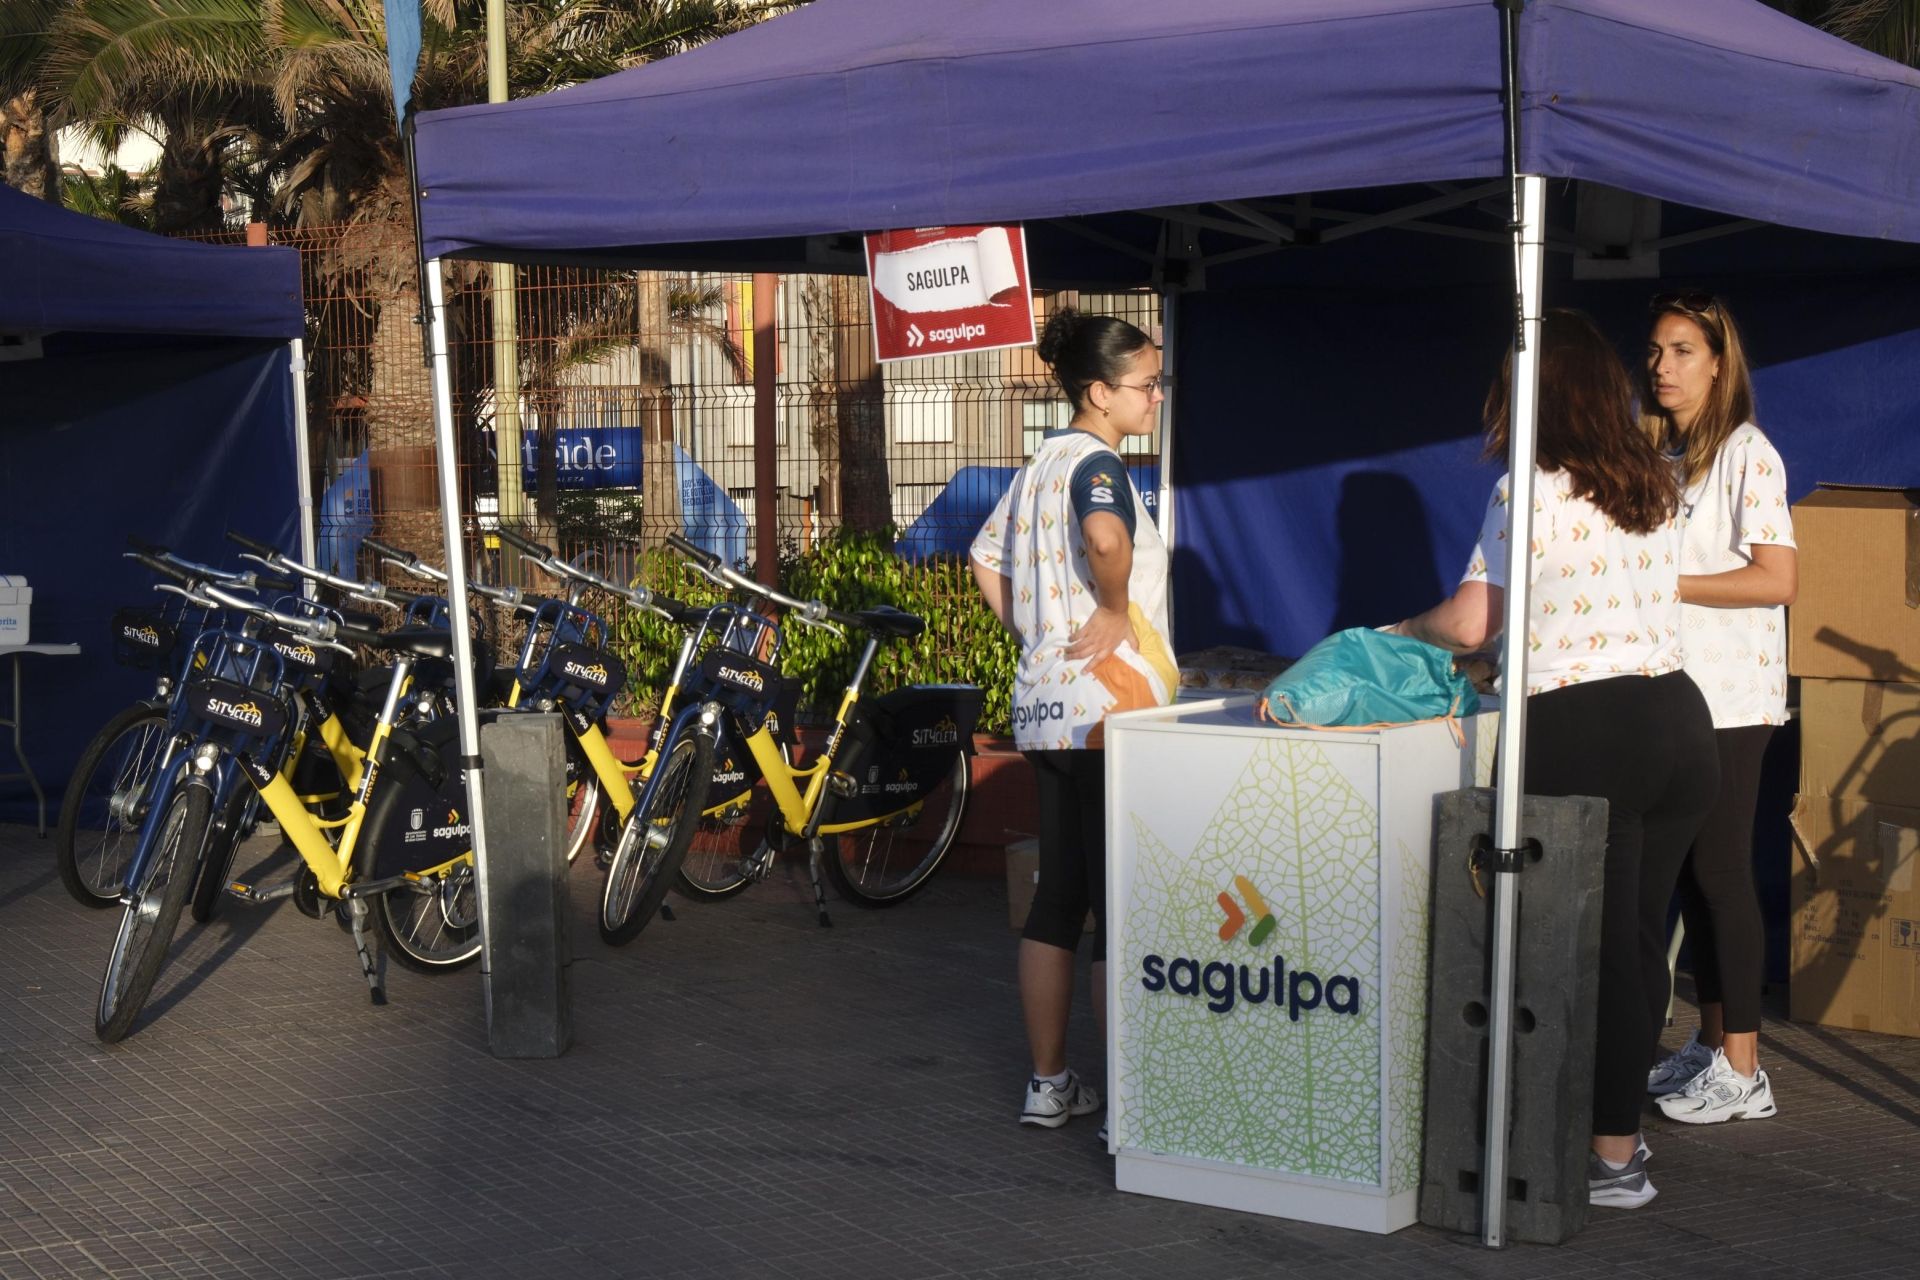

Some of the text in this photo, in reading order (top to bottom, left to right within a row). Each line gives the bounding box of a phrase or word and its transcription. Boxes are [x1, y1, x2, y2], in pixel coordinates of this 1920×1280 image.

[906, 265, 970, 292] SAGULPA
[928, 322, 986, 344] sagulpa
[207, 698, 262, 727] SITYCLETA
[1012, 697, 1064, 730] agulpa
[885, 782, 919, 794] sagulpa
[1141, 953, 1360, 1022] sagulpa
